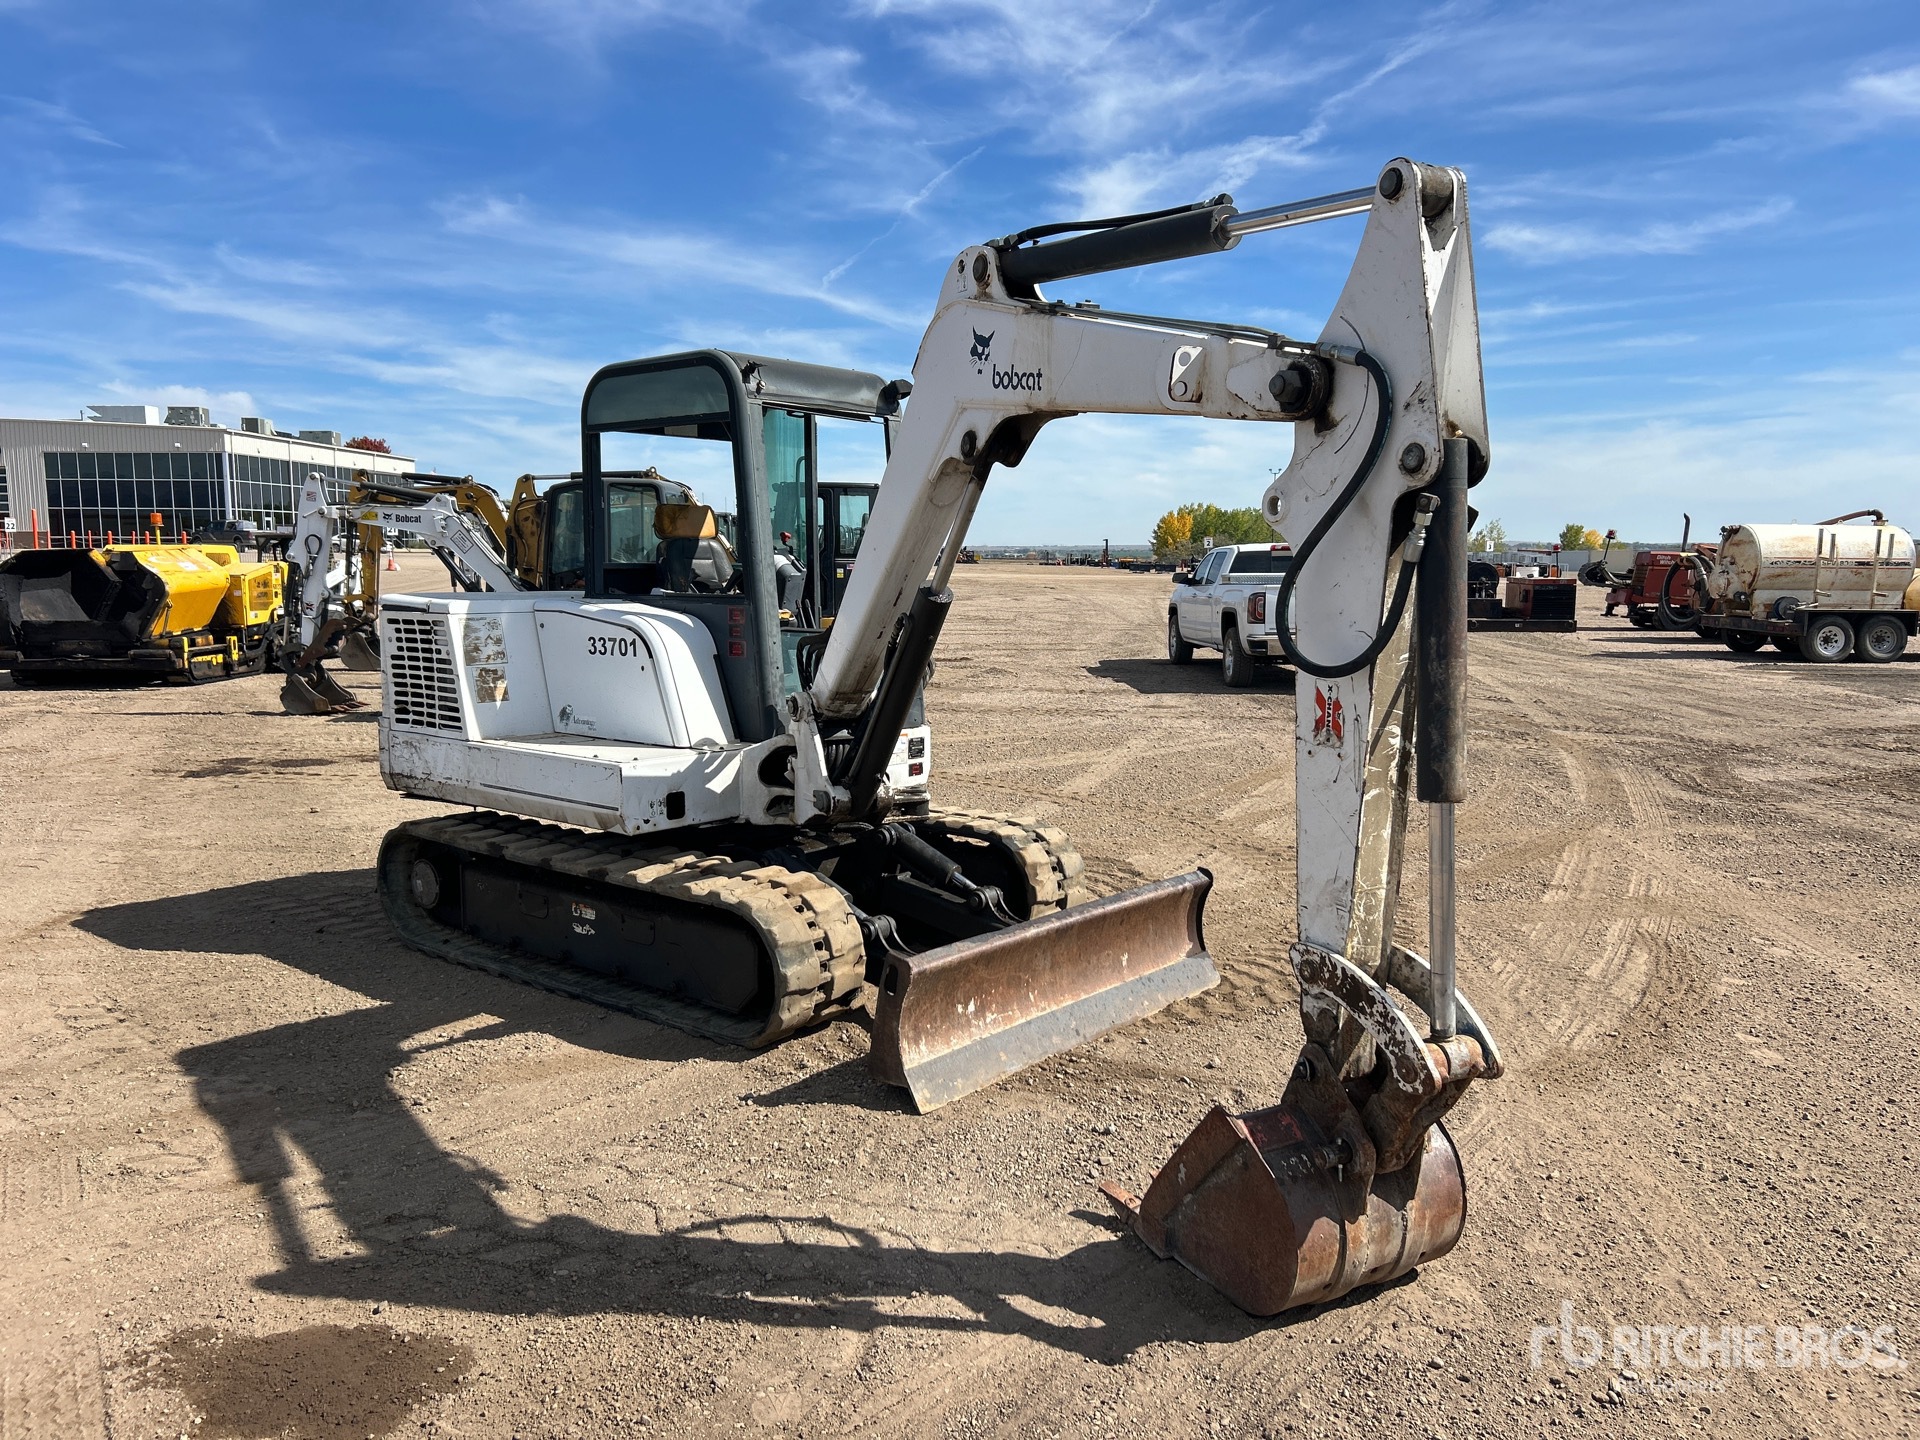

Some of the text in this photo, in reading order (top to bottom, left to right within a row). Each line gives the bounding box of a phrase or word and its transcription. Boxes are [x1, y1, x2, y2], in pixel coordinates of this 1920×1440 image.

[992, 364, 1043, 391] bobcat
[5, 522, 16, 530] 22
[395, 514, 422, 524] Bobcat
[587, 636, 638, 658] 33701
